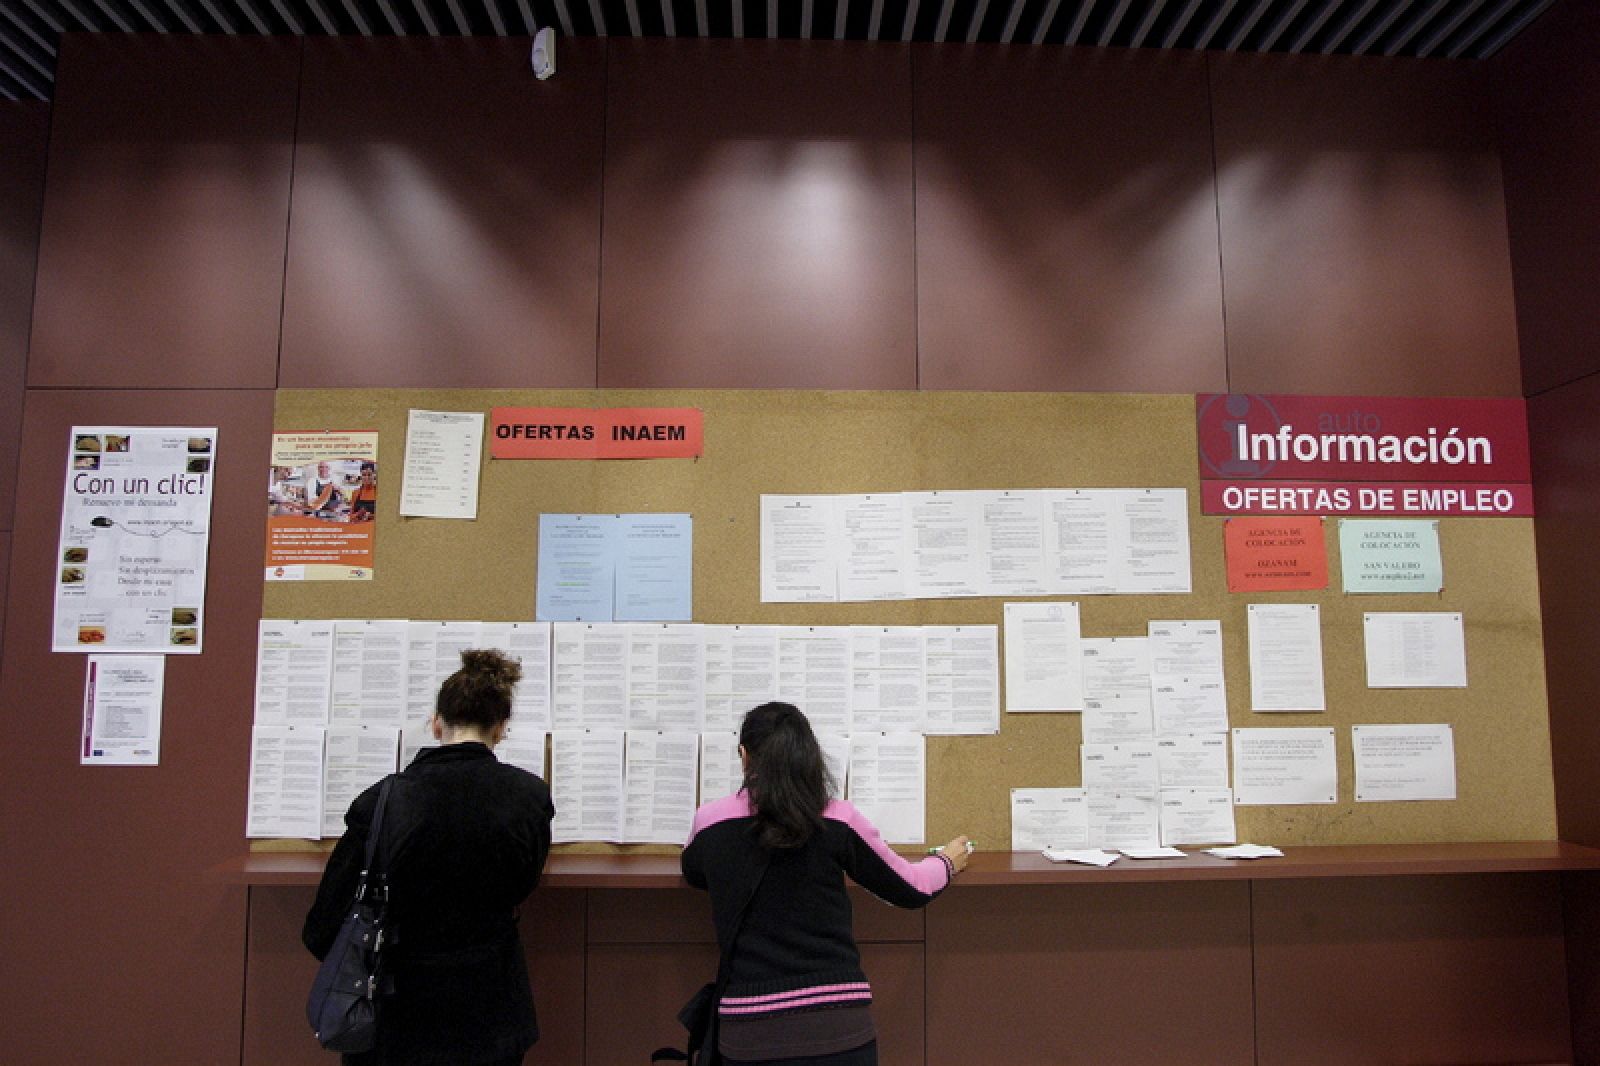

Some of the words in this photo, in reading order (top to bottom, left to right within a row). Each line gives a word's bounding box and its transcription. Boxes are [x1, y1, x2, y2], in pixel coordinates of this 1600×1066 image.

[1318, 410, 1381, 432] auto
[496, 424, 595, 440] OFERTAS
[611, 425, 685, 441] INAEM
[1237, 423, 1492, 464] Información
[73, 473, 115, 495] Con
[123, 477, 149, 495] un
[157, 473, 205, 495] clic!
[1222, 487, 1352, 511] OFERTAS
[1359, 488, 1395, 511] DE
[1403, 488, 1513, 512] EMPLEO
[1248, 528, 1289, 537] AGENCIA
[1290, 528, 1301, 536] DE
[1363, 531, 1403, 539] AGENCIA
[1404, 531, 1417, 539] DE
[1363, 561, 1382, 569] SAN
